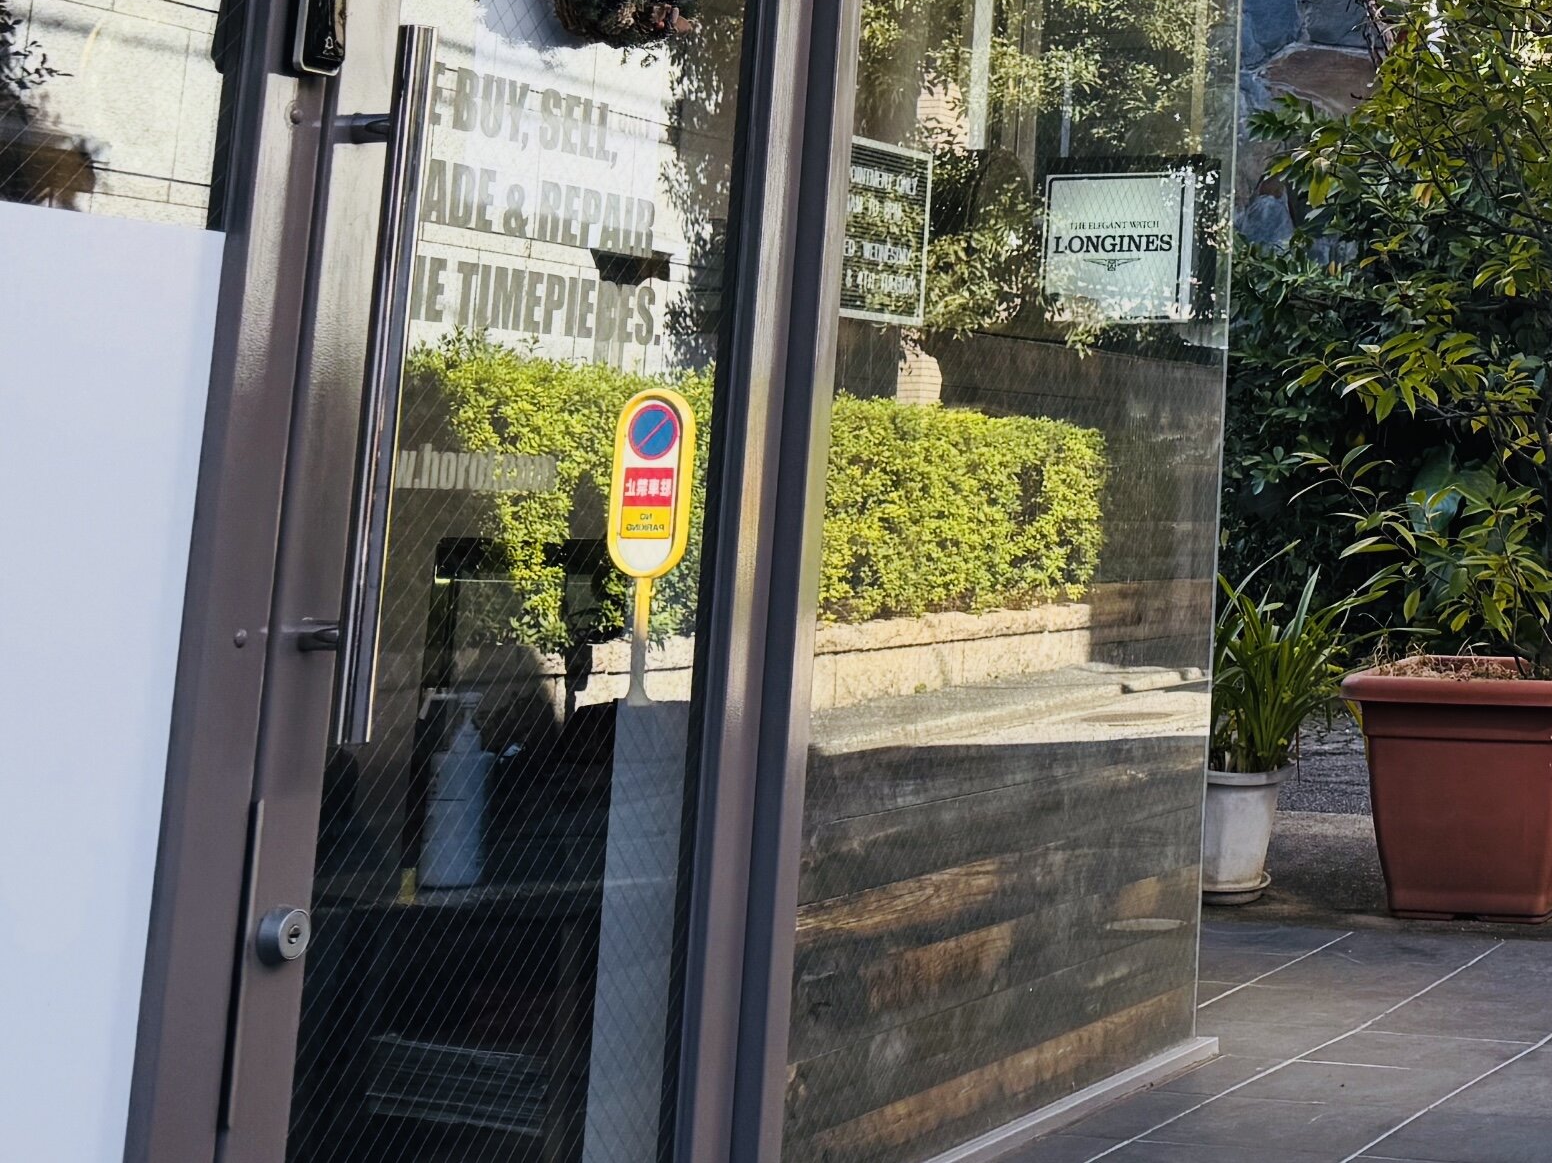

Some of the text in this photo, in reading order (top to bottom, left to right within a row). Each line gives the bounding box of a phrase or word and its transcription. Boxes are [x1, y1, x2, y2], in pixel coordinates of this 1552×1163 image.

[452, 66, 530, 151] BUY,
[538, 87, 619, 170] SELL,
[422, 158, 656, 258] ADE & REPAIR
[1070, 220, 1160, 230] THE ELEGANT WATCH
[1053, 234, 1173, 254] LONGINES
